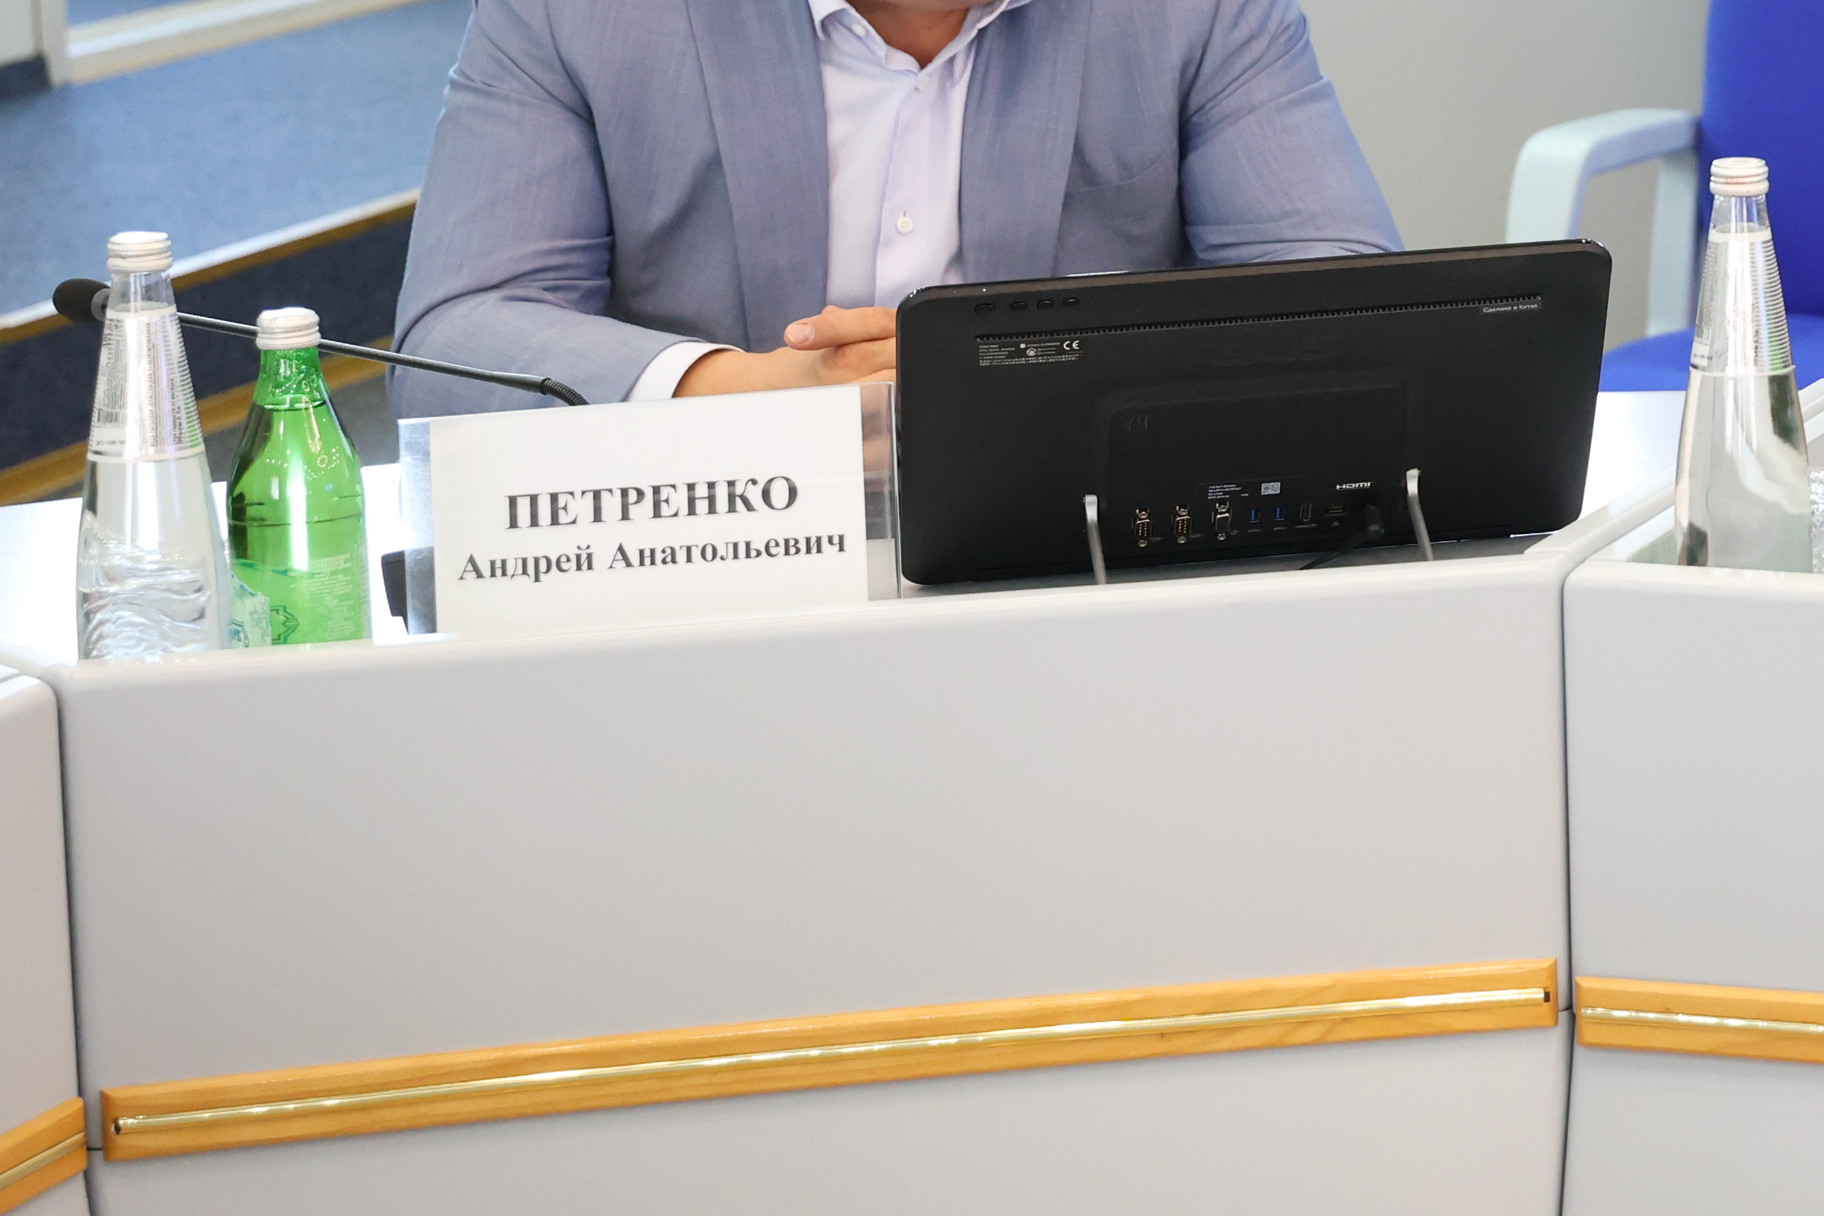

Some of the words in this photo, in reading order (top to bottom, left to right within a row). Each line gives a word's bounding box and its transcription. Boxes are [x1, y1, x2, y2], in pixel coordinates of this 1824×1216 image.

[505, 475, 798, 530] ПЕТРЕНКО
[1336, 481, 1372, 490] HDMI
[458, 545, 594, 583] Андрей
[609, 535, 845, 568] Анатольевич
